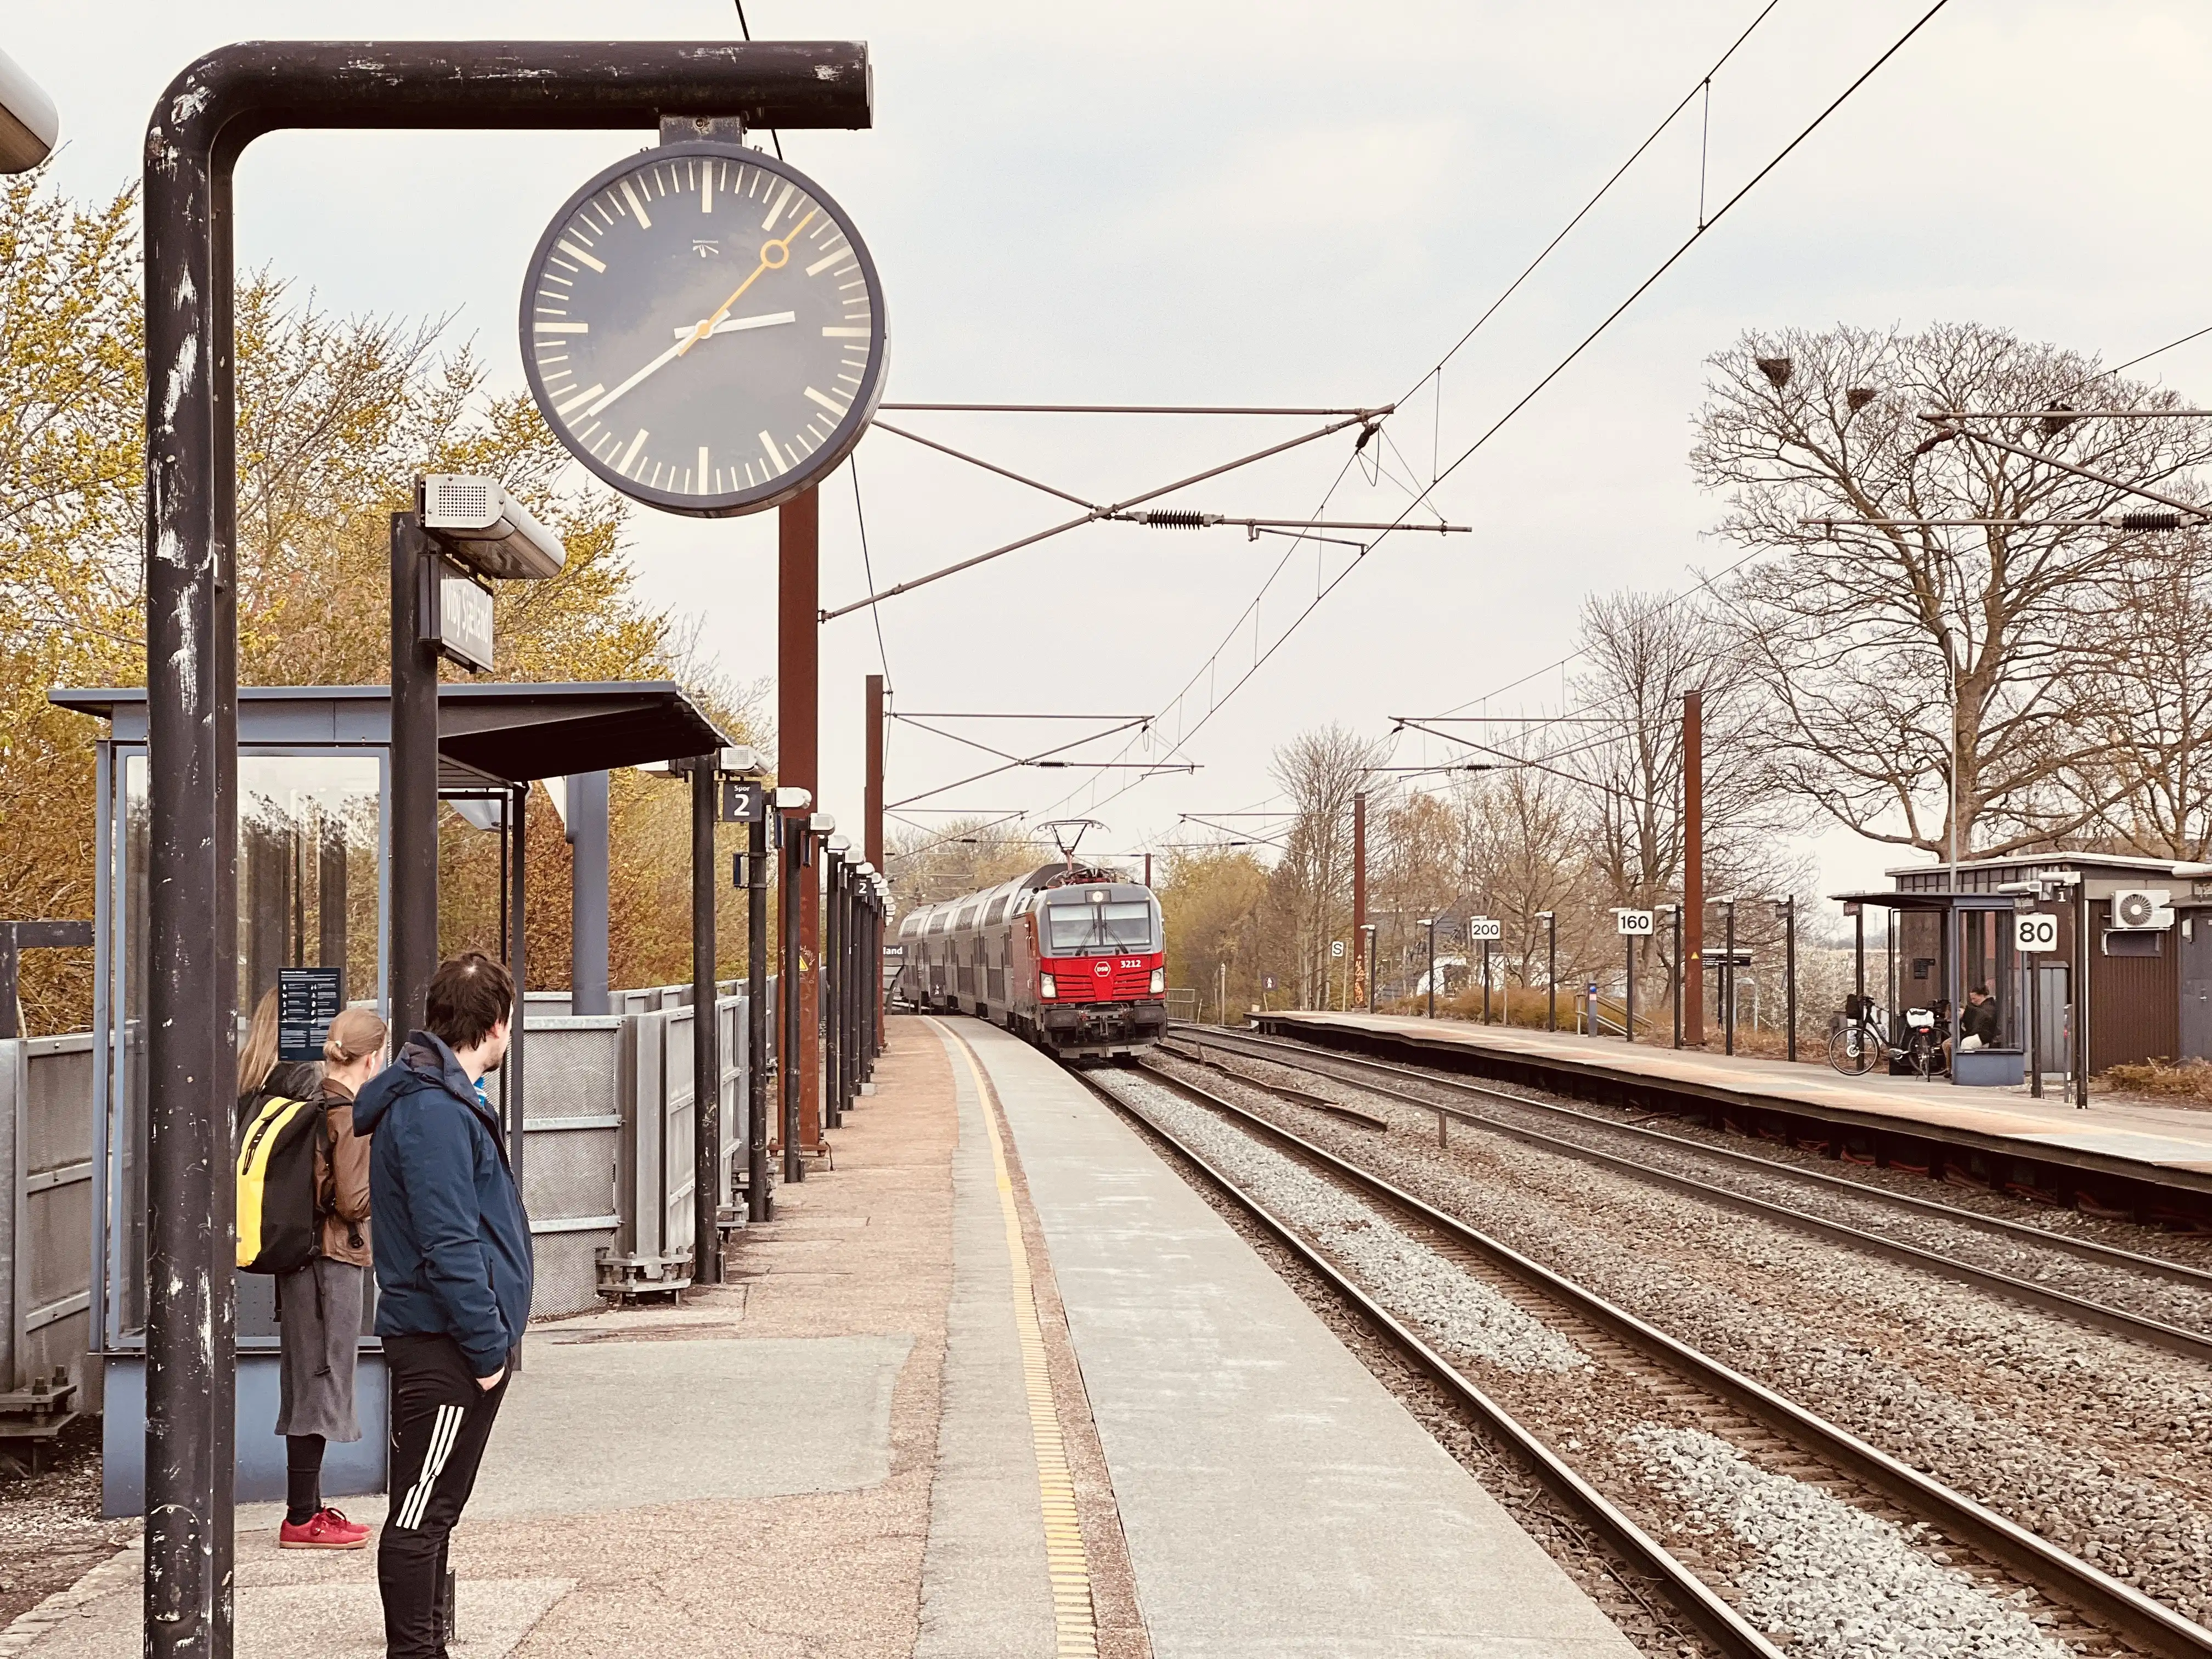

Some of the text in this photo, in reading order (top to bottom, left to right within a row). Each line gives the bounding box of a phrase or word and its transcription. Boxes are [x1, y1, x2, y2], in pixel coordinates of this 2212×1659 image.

[446, 573, 461, 638] Viby
[734, 794, 749, 816] 2
[859, 883, 867, 894] 2
[2058, 891, 2066, 902] 1
[1621, 916, 1649, 929] 160
[1473, 924, 1498, 935] 200
[2019, 922, 2053, 943] 80
[883, 946, 903, 955] land
[1333, 943, 1342, 955] S
[1120, 960, 1141, 968] 3212
